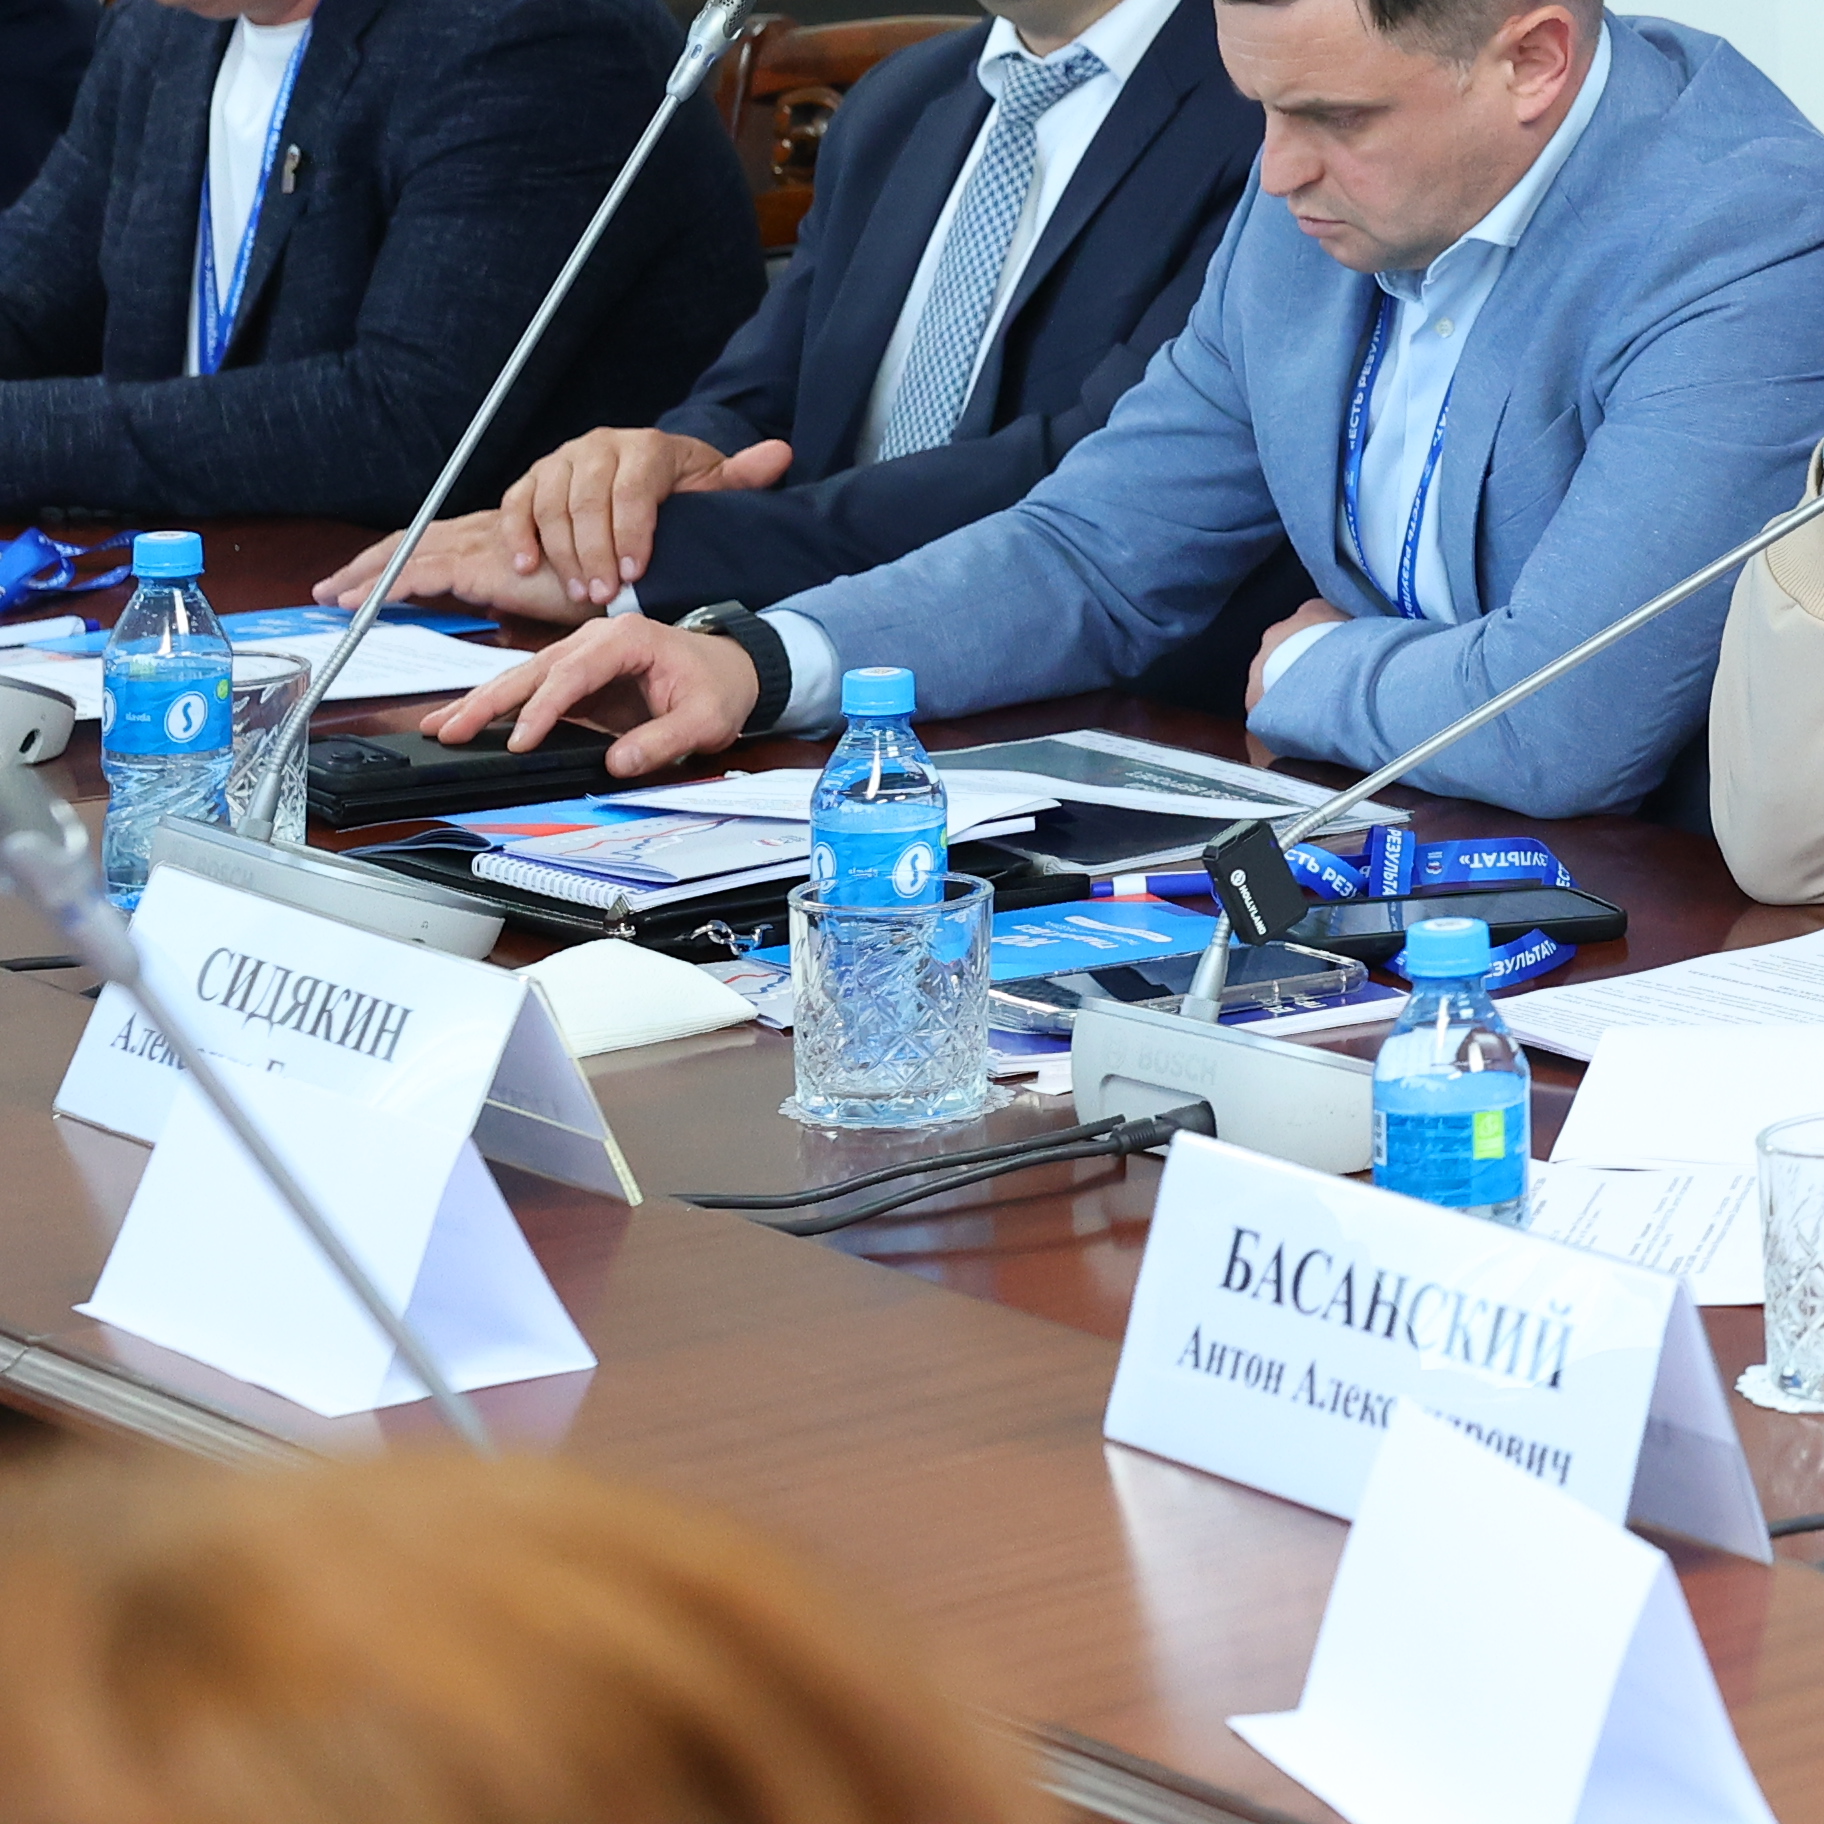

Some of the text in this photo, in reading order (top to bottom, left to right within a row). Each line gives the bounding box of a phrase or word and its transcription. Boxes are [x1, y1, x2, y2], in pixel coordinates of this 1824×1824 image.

[1381, 826, 1403, 896] РЕЗУЛЬТА
[1238, 884, 1267, 936] HOLLYLAND
[196, 946, 416, 1064] СИДЯКИН
[1217, 1224, 1577, 1394] БАСАНСКИЙ
[1173, 1320, 1288, 1397] Антон
